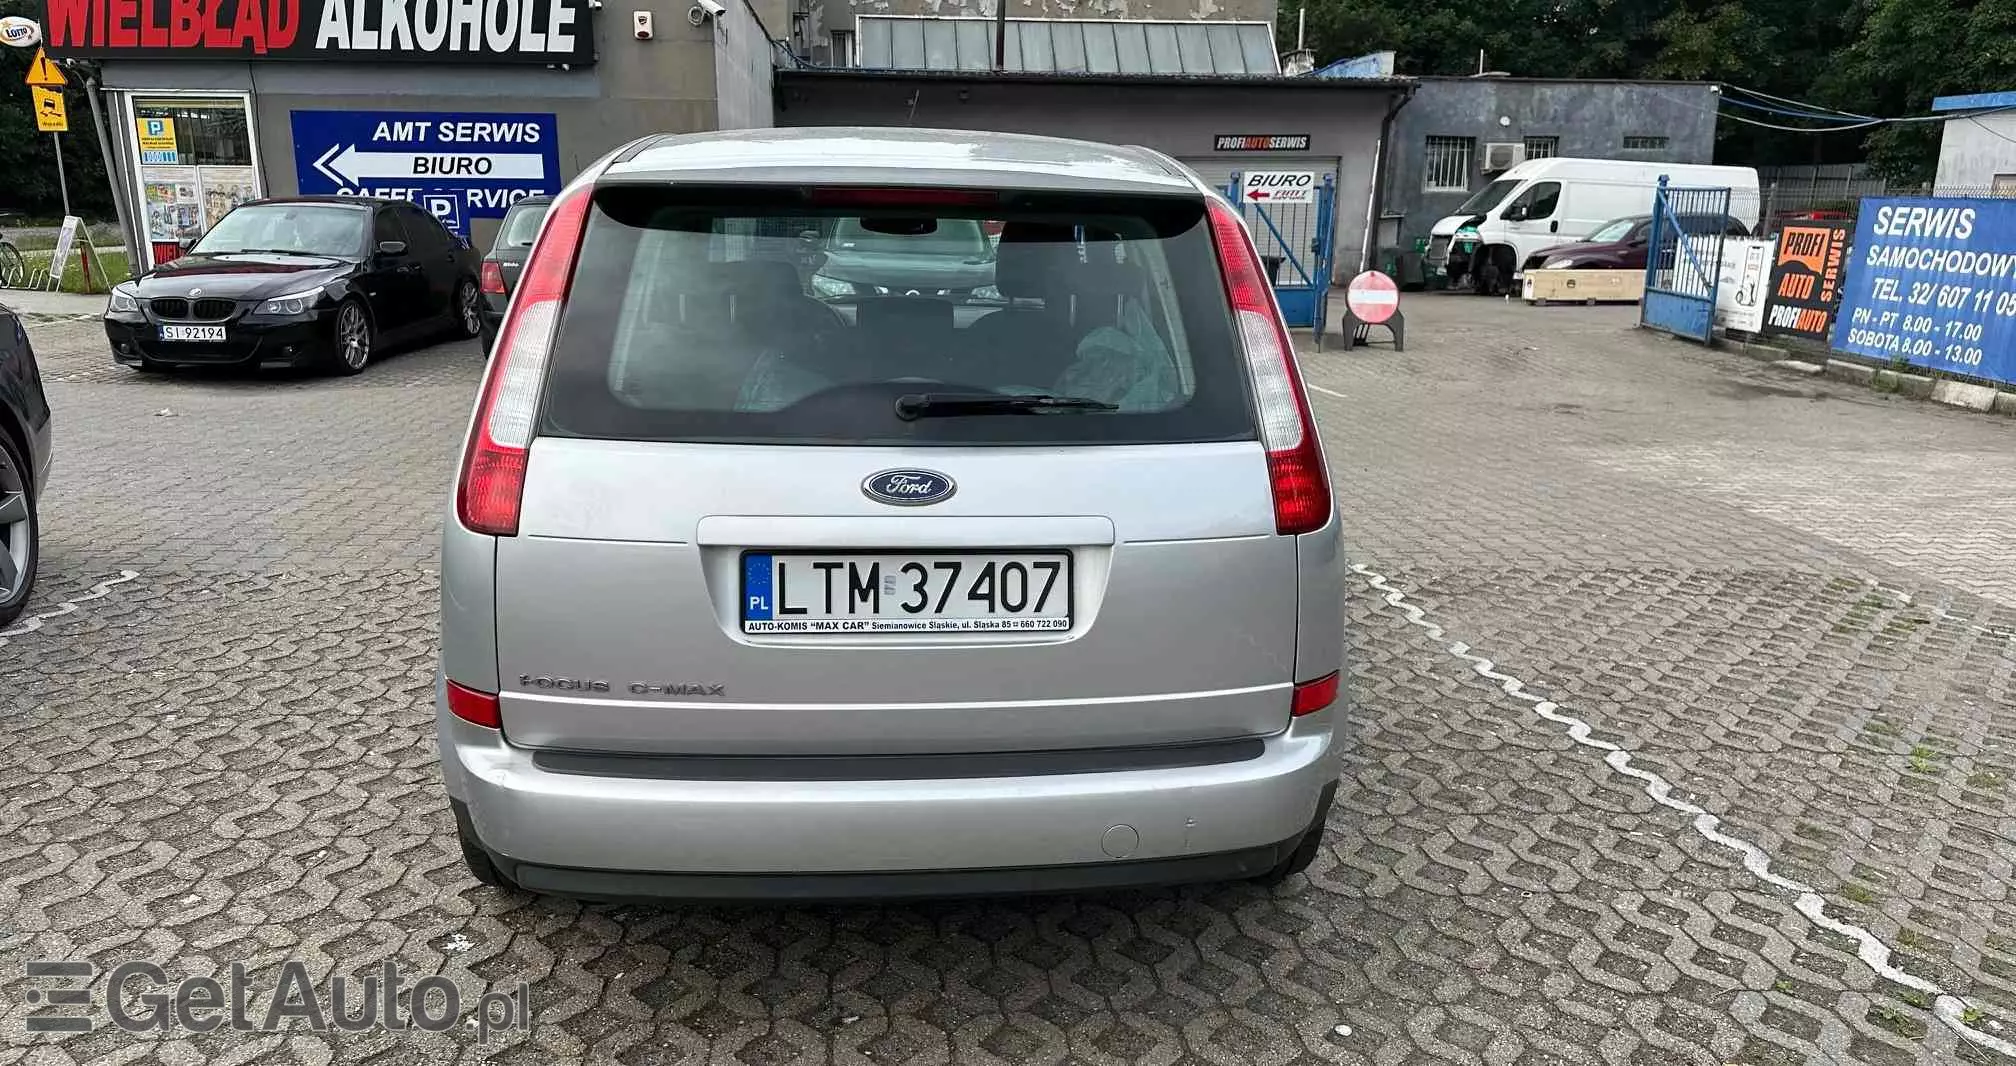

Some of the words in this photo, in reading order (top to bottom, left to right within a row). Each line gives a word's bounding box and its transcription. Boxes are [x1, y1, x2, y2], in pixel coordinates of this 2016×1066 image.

[6, 27, 27, 38] LOTTO
[315, 0, 575, 52] ALKOHOLE
[372, 121, 431, 142] AMT
[438, 122, 541, 143] SERWIS
[1217, 136, 1307, 149] PROFIAUTOSERWIS
[412, 156, 492, 175] BIURO
[1247, 174, 1311, 187] BIURO
[1873, 206, 1976, 239] SERWIS
[1784, 232, 1826, 257] PROFI
[1820, 228, 1846, 302] SERWIS
[1777, 273, 1815, 300] AUTO
[1872, 278, 1902, 302] TEL.
[1908, 281, 1938, 306] 32/
[1937, 285, 1972, 310] 607
[1974, 289, 1994, 313] 11
[1996, 291, 2016, 316] 05
[1768, 304, 1828, 333] PROFIAUTO
[1852, 307, 1872, 324] PN
[1880, 311, 1899, 329] PT
[1902, 315, 1932, 334] 8.00
[1945, 320, 1983, 342] 17.00
[166, 327, 179, 338] SI
[185, 327, 224, 339] 92194
[1848, 328, 1900, 352] SOBOTA
[1901, 338, 1932, 356] 8.00
[1945, 344, 1982, 366] 13.00
[886, 475, 934, 493] Ford
[778, 561, 880, 614] LTM
[900, 561, 1061, 613] 37407
[750, 597, 769, 610] PL
[748, 622, 808, 631] AUTO-KOMIS
[871, 620, 927, 630] Siemianowice
[961, 620, 972, 629] ul.
[1001, 620, 1012, 628] 85
[1036, 619, 1052, 628] 722
[1052, 619, 1067, 628] 090
[519, 673, 610, 692] FOCUS
[629, 680, 726, 696] C-MAX
